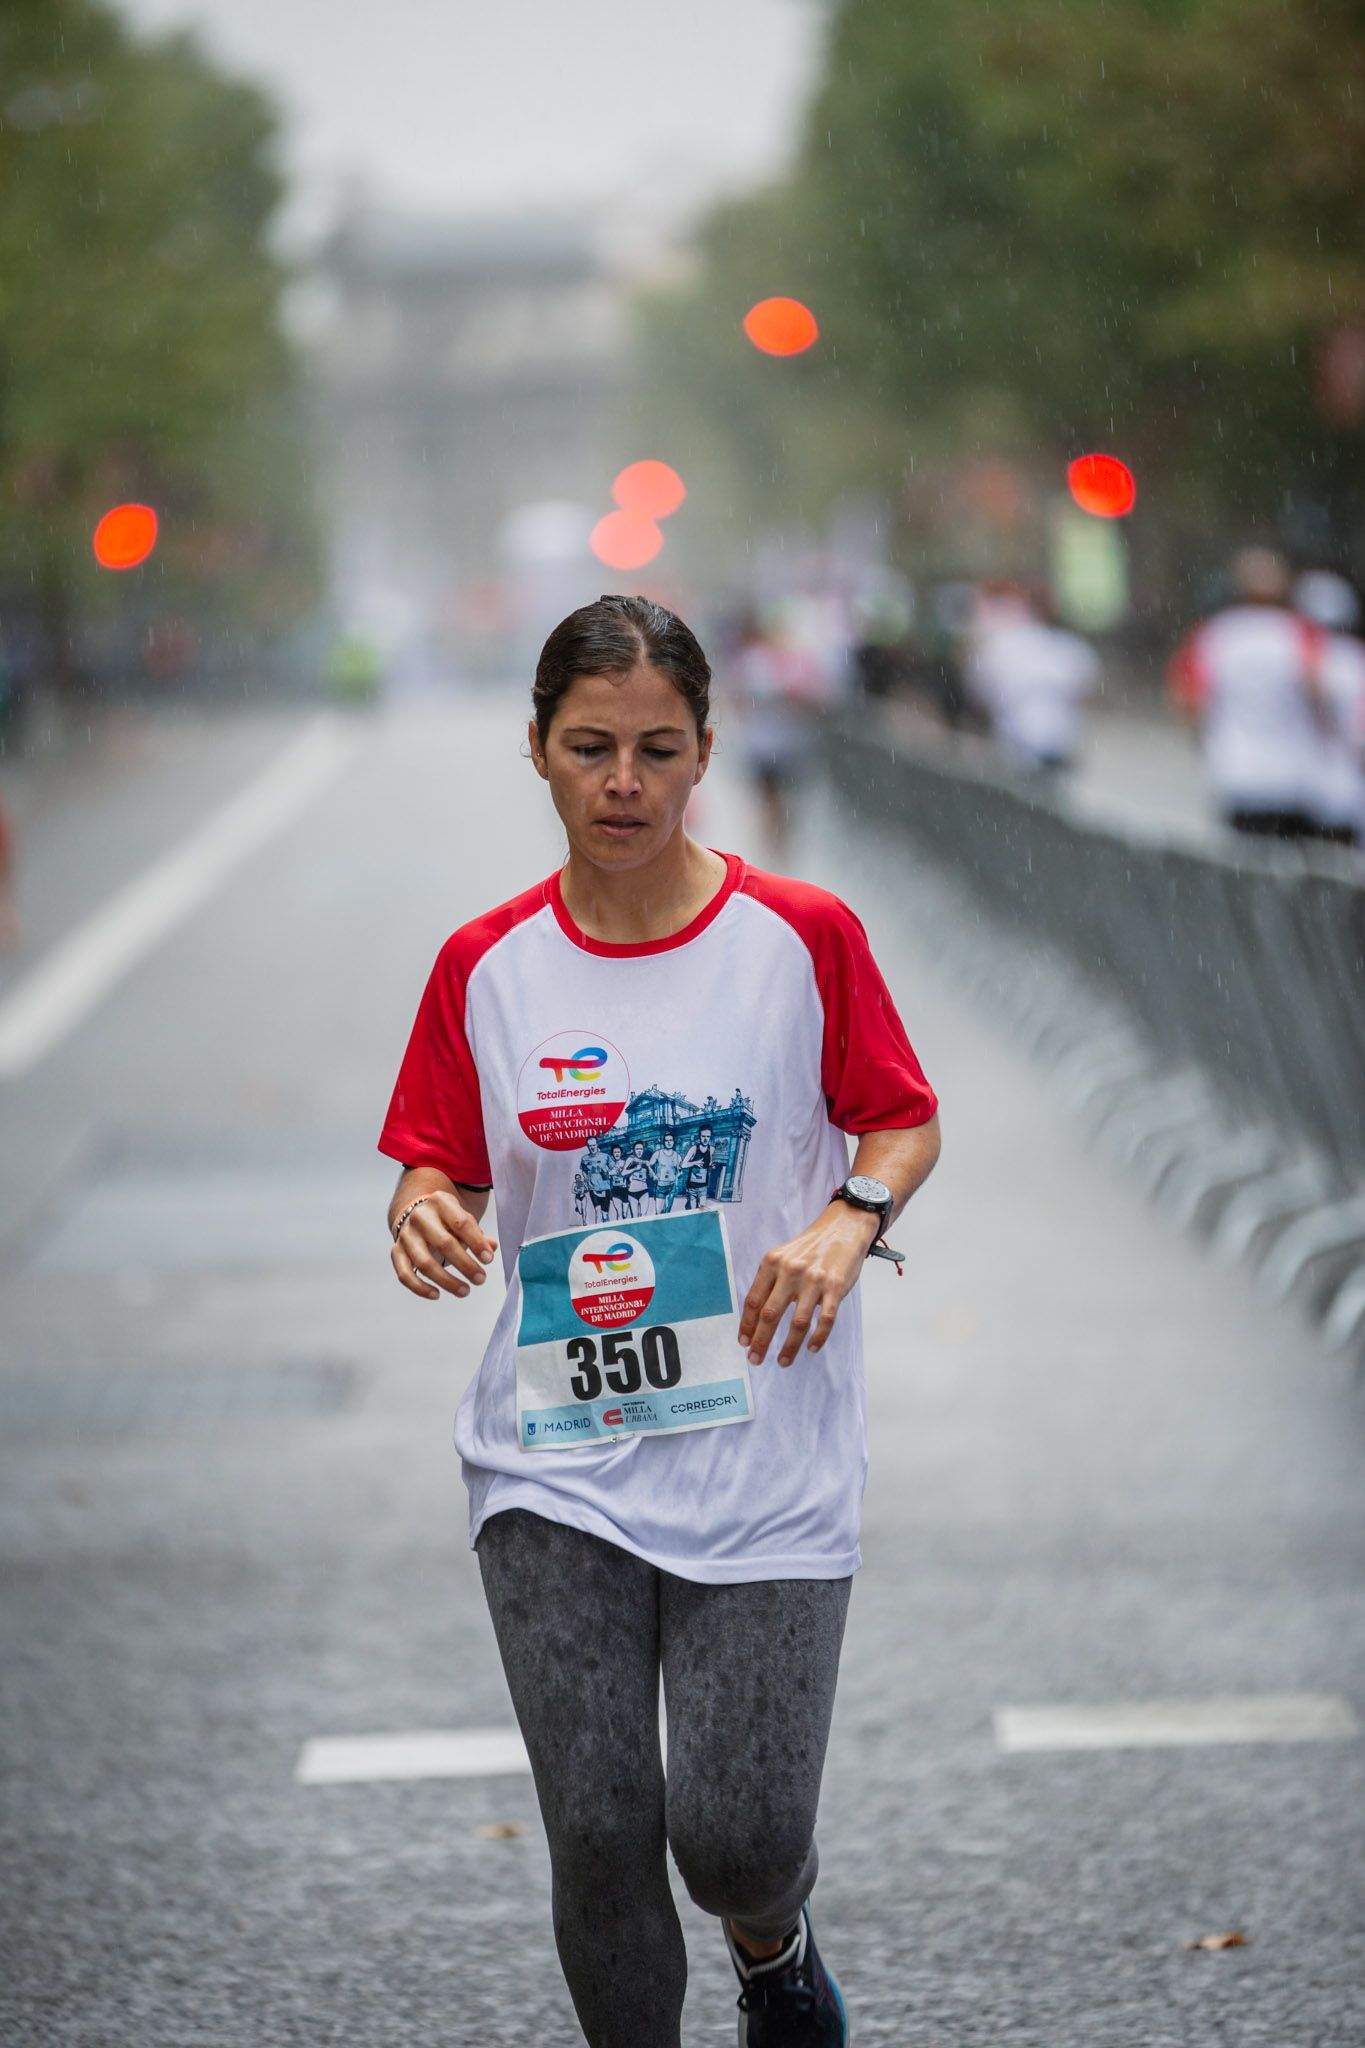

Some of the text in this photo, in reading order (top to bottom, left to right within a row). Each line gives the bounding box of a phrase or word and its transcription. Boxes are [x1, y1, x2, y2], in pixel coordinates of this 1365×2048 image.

[537, 1086, 606, 1100] TotalEnergies
[550, 1108, 584, 1118] MILLA
[540, 1128, 597, 1143] DE MADRID
[584, 1275, 639, 1289] TotalEnergies
[598, 1293, 625, 1304] MILLA
[591, 1309, 637, 1323] DE MADRID
[566, 1325, 682, 1401] 350
[624, 1405, 652, 1414] MILLA
[544, 1417, 591, 1433] MADRID
